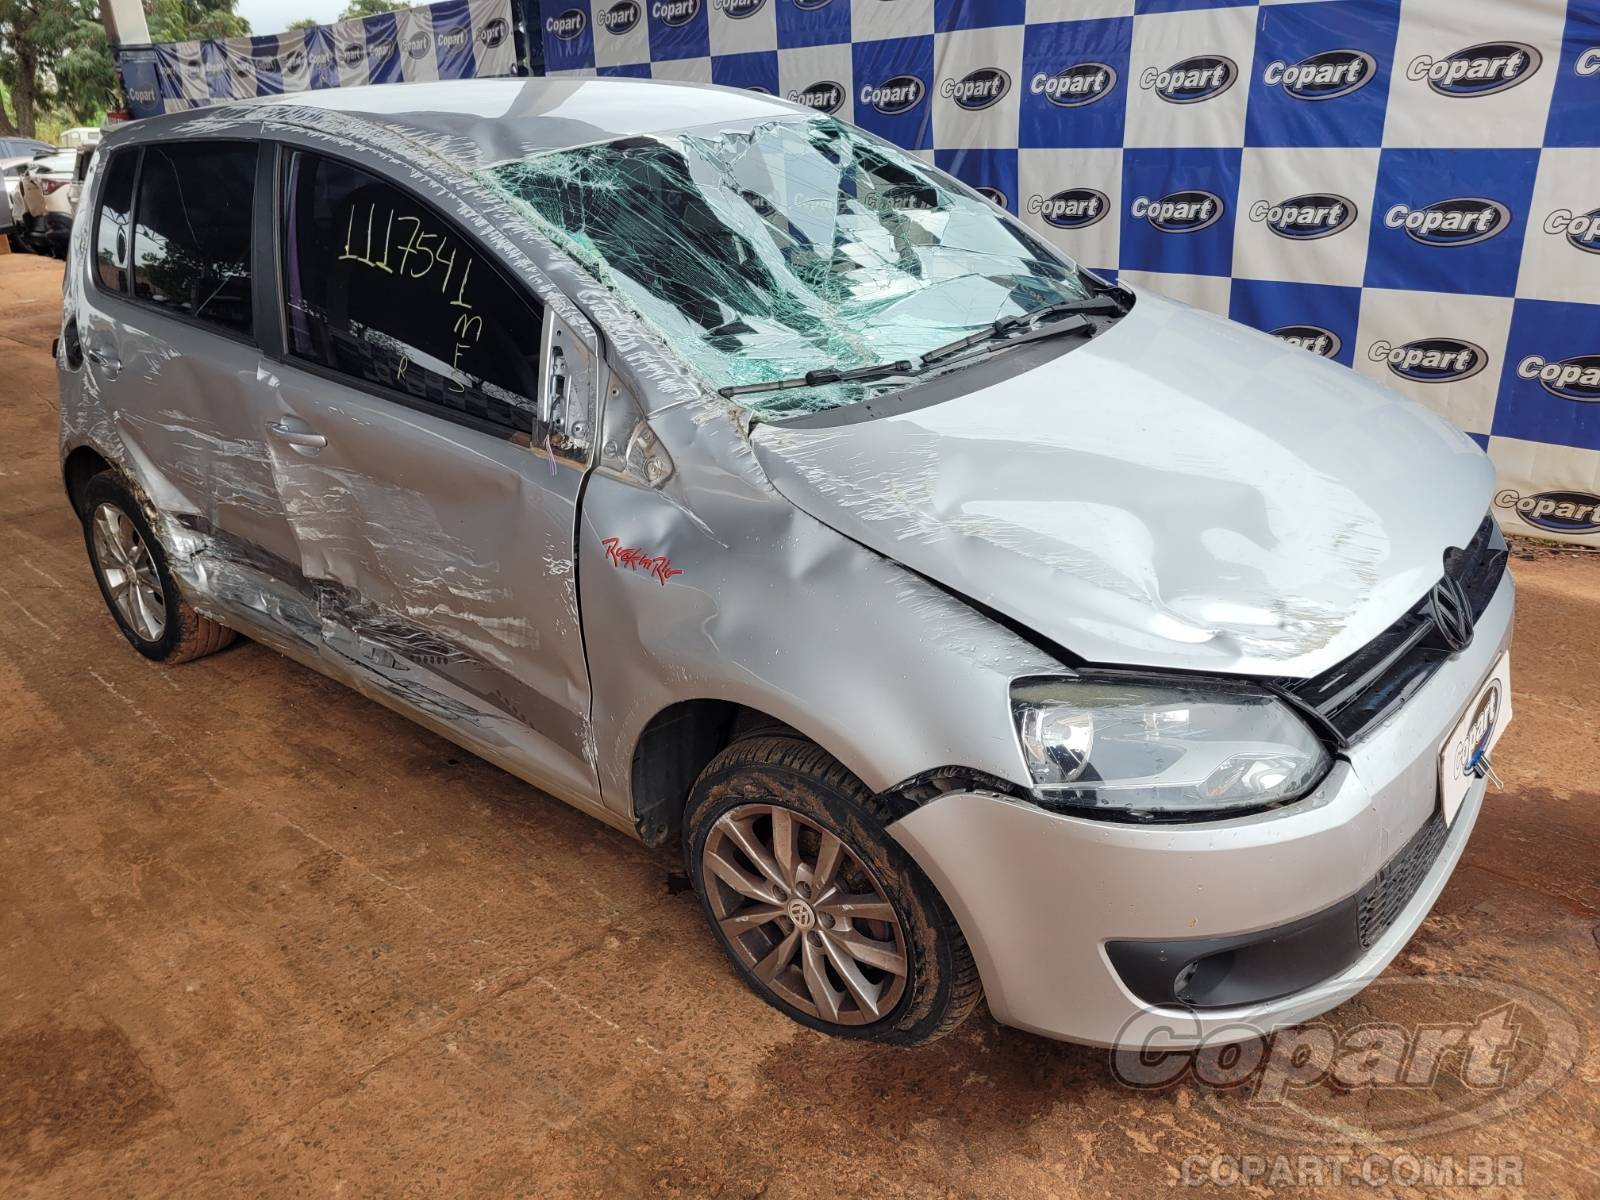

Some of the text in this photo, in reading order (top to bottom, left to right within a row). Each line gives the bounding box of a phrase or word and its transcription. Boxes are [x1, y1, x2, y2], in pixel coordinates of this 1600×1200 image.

[598, 6, 635, 26] Copart
[652, 0, 694, 19] Copart
[546, 15, 582, 33] Copart
[438, 32, 465, 48] Copart
[1139, 60, 1225, 93] Copart
[1263, 50, 1363, 91] Copart
[1406, 47, 1524, 84] Copart
[129, 87, 155, 102] Copart
[860, 82, 916, 105] Copart
[940, 70, 1001, 98] Copart
[1030, 71, 1105, 97] Copart
[787, 89, 838, 108] Copart
[1026, 193, 1098, 220] Copart
[1131, 196, 1213, 222] Copart
[1248, 201, 1343, 229] Copart
[1384, 204, 1495, 236] Copart
[1367, 339, 1473, 371] Copart
